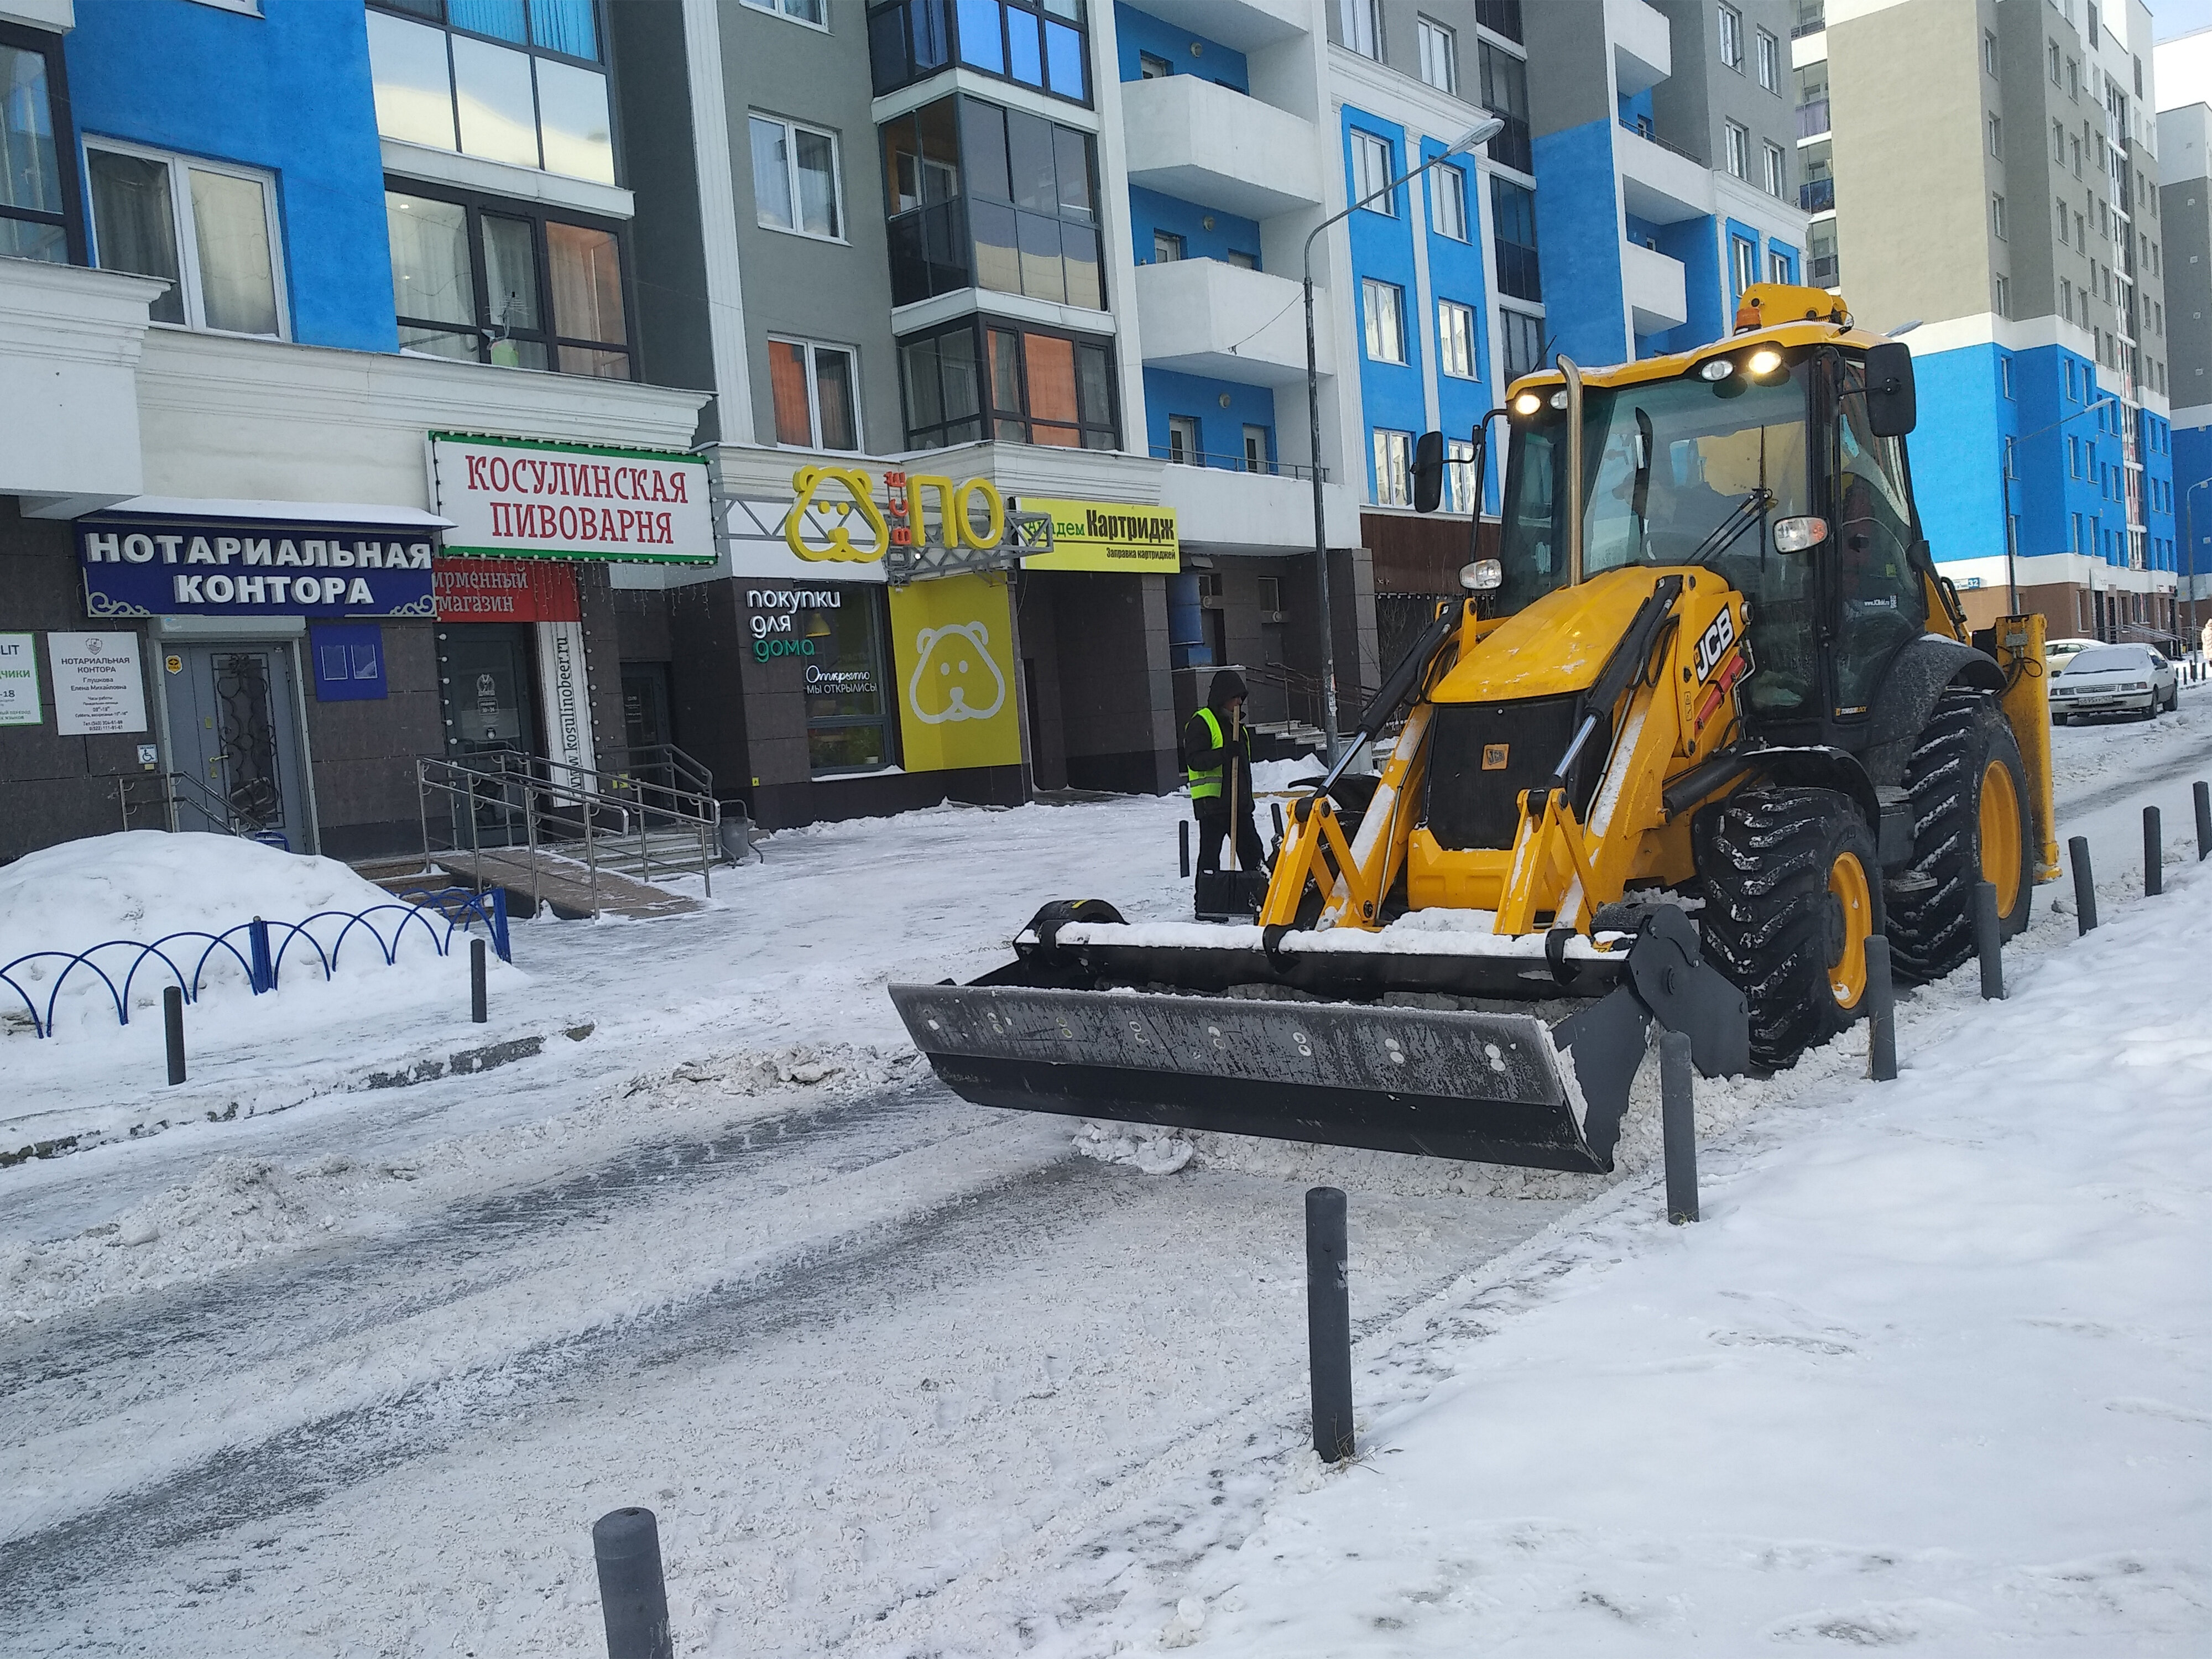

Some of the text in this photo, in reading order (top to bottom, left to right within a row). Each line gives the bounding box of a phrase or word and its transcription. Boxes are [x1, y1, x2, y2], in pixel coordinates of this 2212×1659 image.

[466, 455, 688, 503] КОСУЛИНСКАЯ
[490, 502, 674, 544] ПИВОВАРНЯ
[906, 474, 1005, 550] ПО
[1086, 509, 1174, 543] Картридж
[85, 533, 432, 570] НОТАРИАЛЬНАЯ
[1107, 547, 1176, 560] Заправка картриджей
[173, 575, 374, 605] КОНТОРА
[434, 565, 528, 594] ирменный
[439, 596, 514, 613] магазин
[747, 589, 841, 614] покупки
[750, 614, 791, 639] для
[0, 645, 19, 655] LIT
[753, 638, 815, 664] дома
[1697, 608, 1733, 681] JCB
[0, 670, 30, 679] ЧИКИ
[806, 665, 870, 683] Открыто
[807, 685, 822, 694] МЫ
